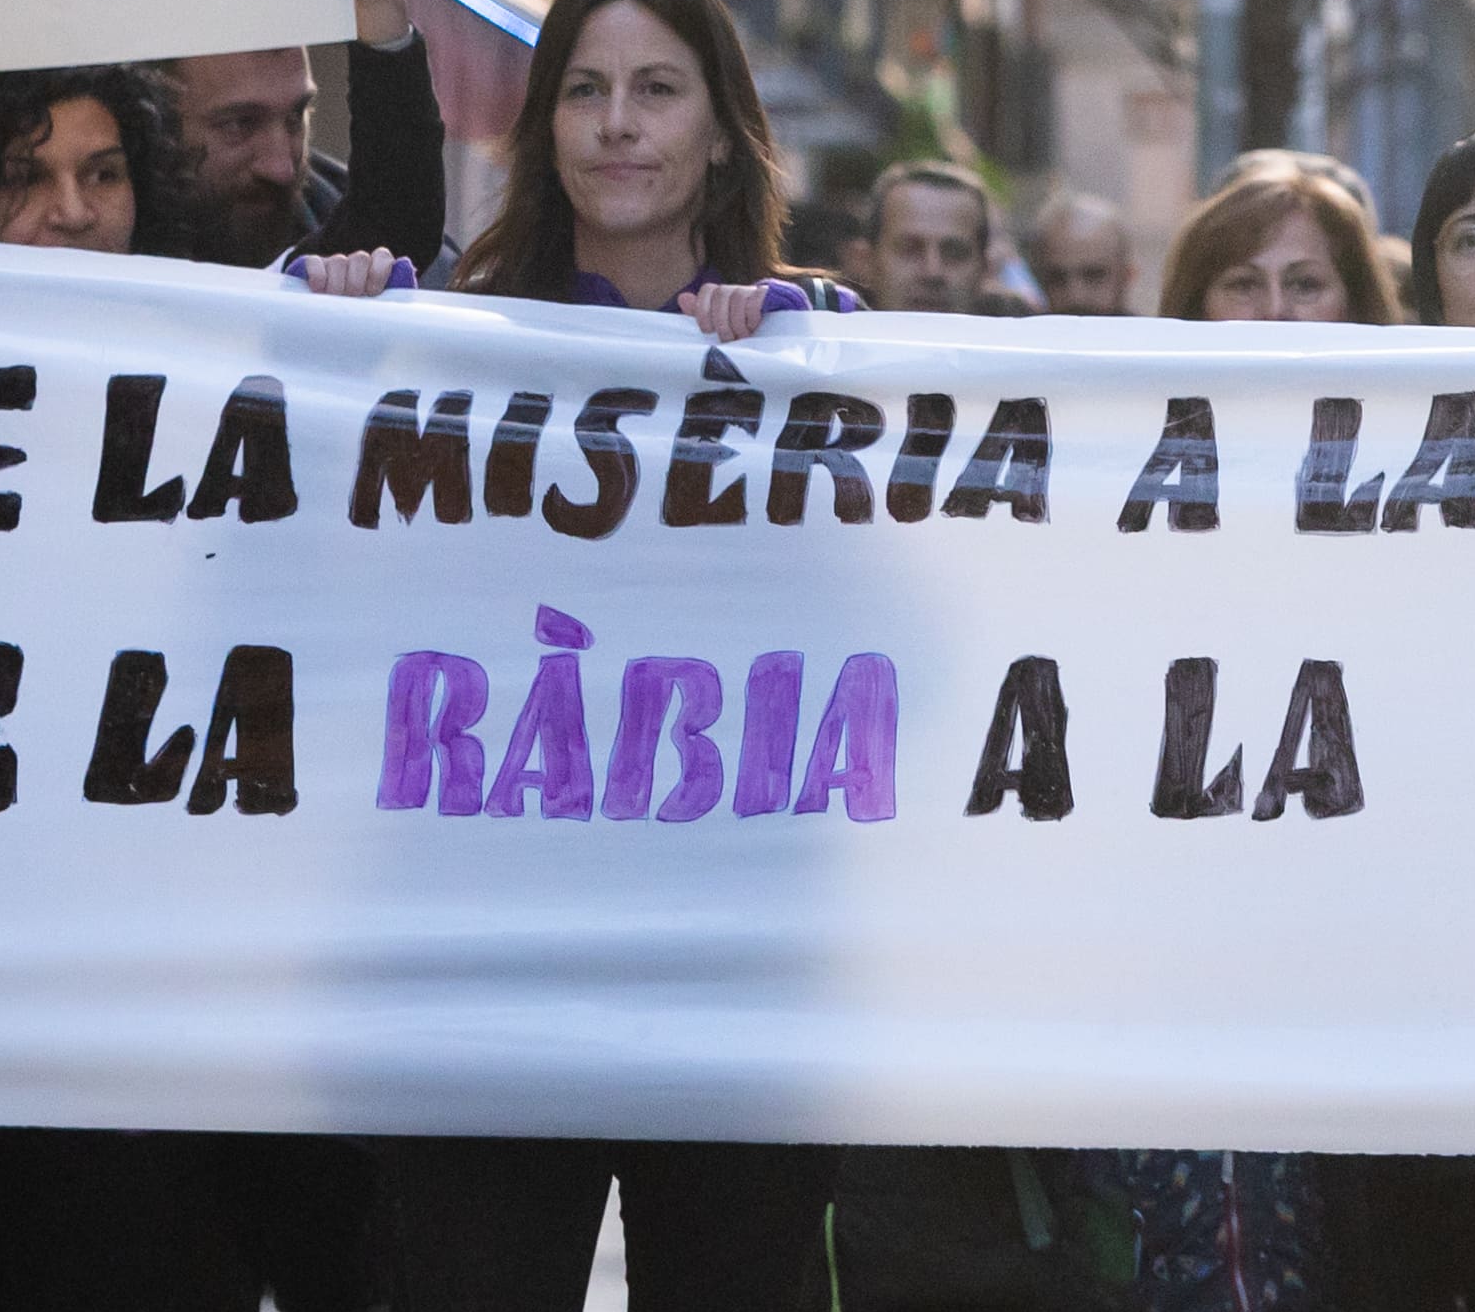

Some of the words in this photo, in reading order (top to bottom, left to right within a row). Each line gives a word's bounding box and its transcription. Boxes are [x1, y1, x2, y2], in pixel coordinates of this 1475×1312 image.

[92, 373, 298, 524] LA
[348, 346, 1051, 540] MISÈRIA
[1117, 396, 1220, 533] A
[82, 644, 299, 816] LA
[375, 602, 898, 822] RÀBIA
[965, 654, 1074, 821] A
[1149, 656, 1364, 821] LA
